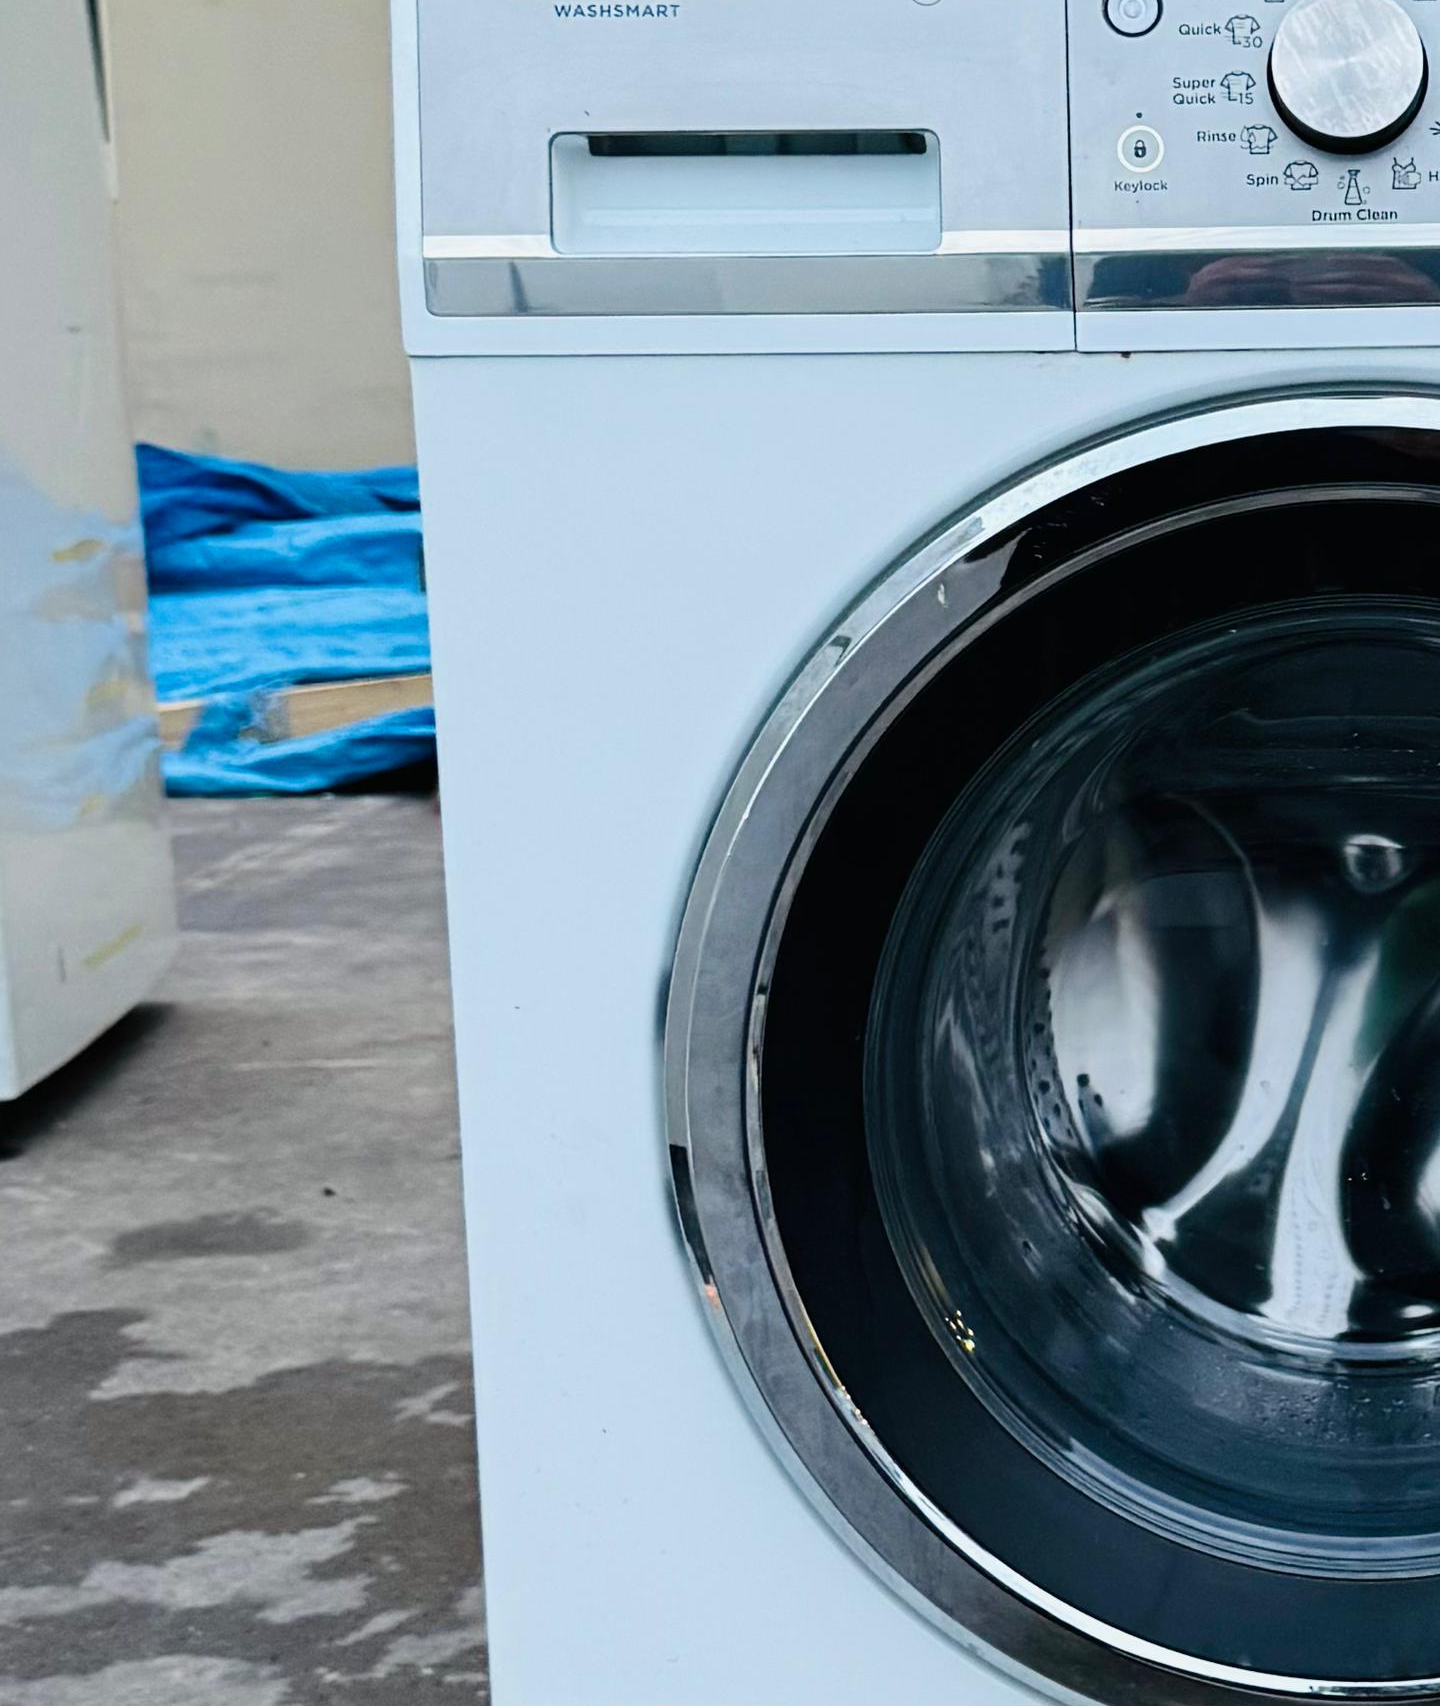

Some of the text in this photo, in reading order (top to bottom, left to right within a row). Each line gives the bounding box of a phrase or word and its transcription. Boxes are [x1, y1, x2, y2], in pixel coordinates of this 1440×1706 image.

[555, 3, 681, 19] WASHSMART
[1179, 22, 1222, 36] Quick
[1242, 36, 1263, 48] 30
[1172, 76, 1215, 91] Super
[1172, 92, 1216, 106] Quick
[1238, 93, 1254, 105] 15
[1197, 130, 1236, 142] Rinse
[1114, 179, 1168, 193] Keylock
[1246, 173, 1279, 188] Spin
[1311, 208, 1398, 222] Drum Clean
